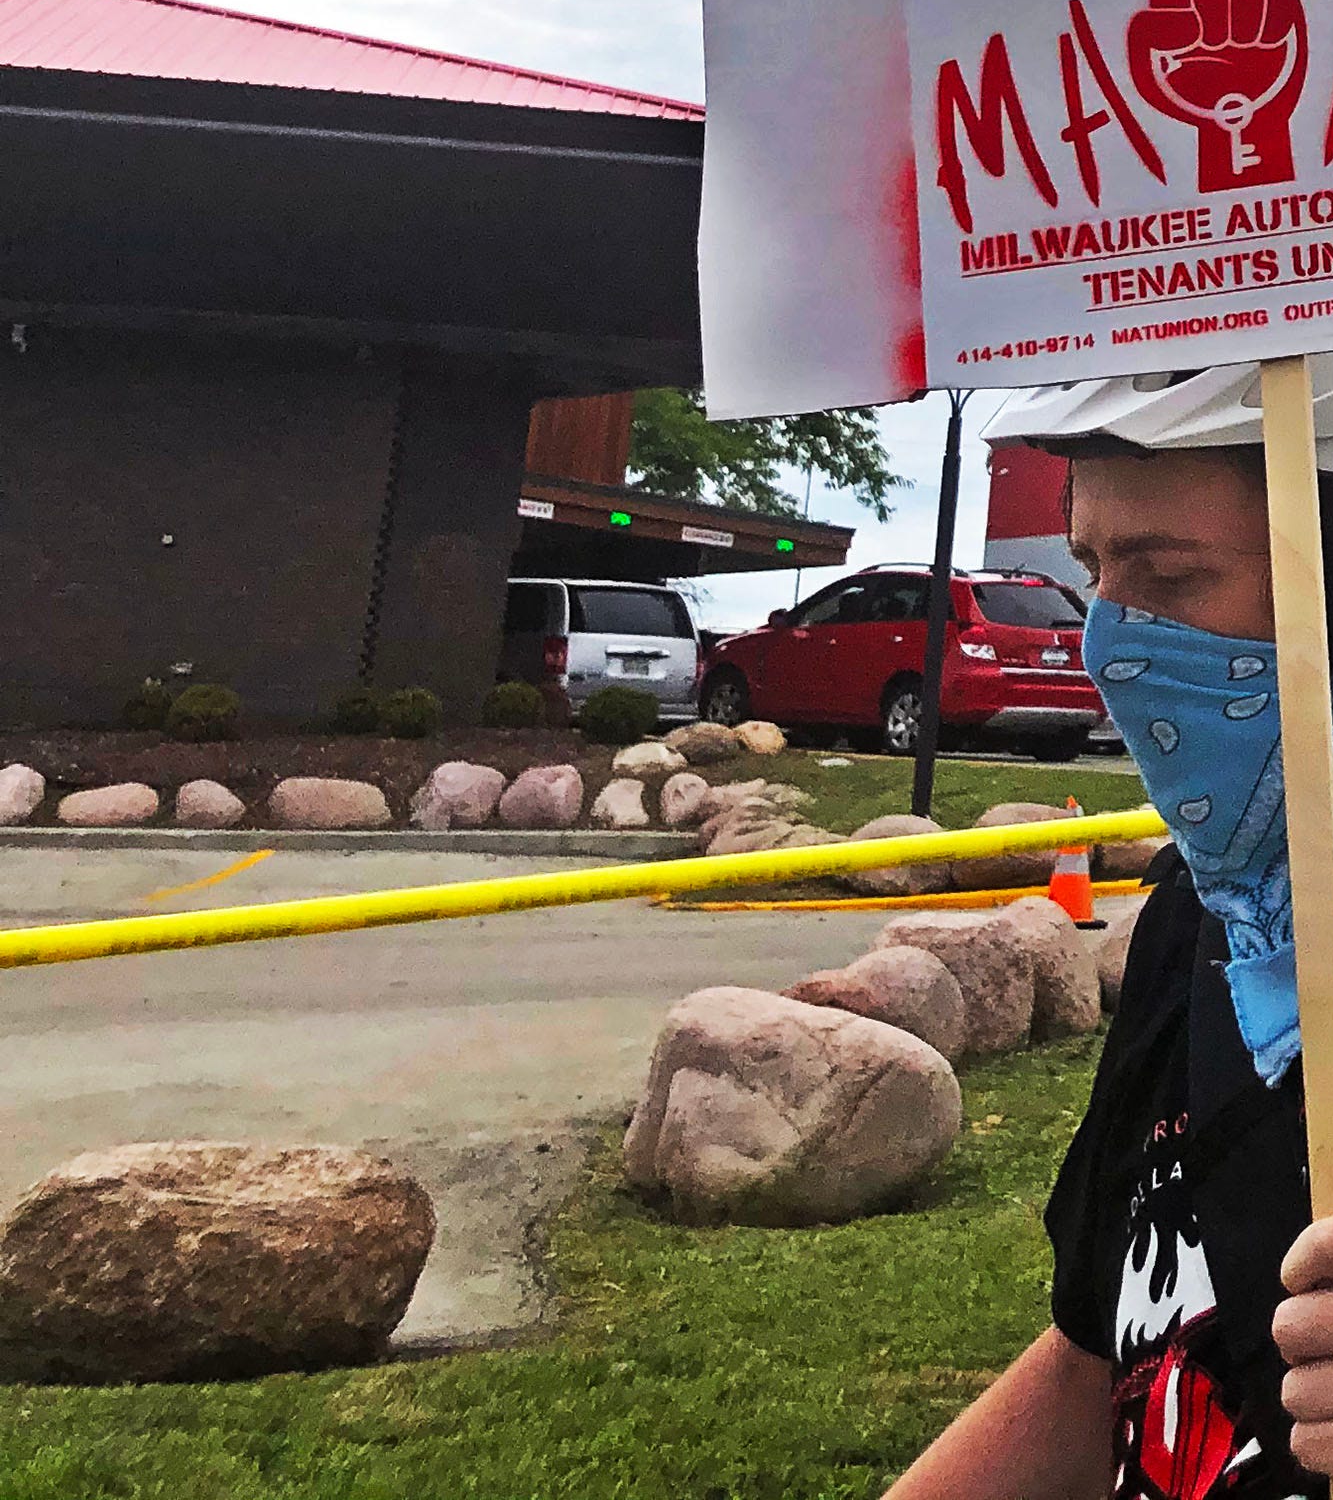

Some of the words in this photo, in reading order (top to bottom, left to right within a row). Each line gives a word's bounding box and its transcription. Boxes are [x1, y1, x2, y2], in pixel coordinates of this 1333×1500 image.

[960, 206, 1213, 272] MILWAUKEE
[1082, 248, 1282, 306] TENANTS
[955, 332, 1096, 366] 414-410-9714
[1111, 308, 1270, 346] MATUNION.ORG
